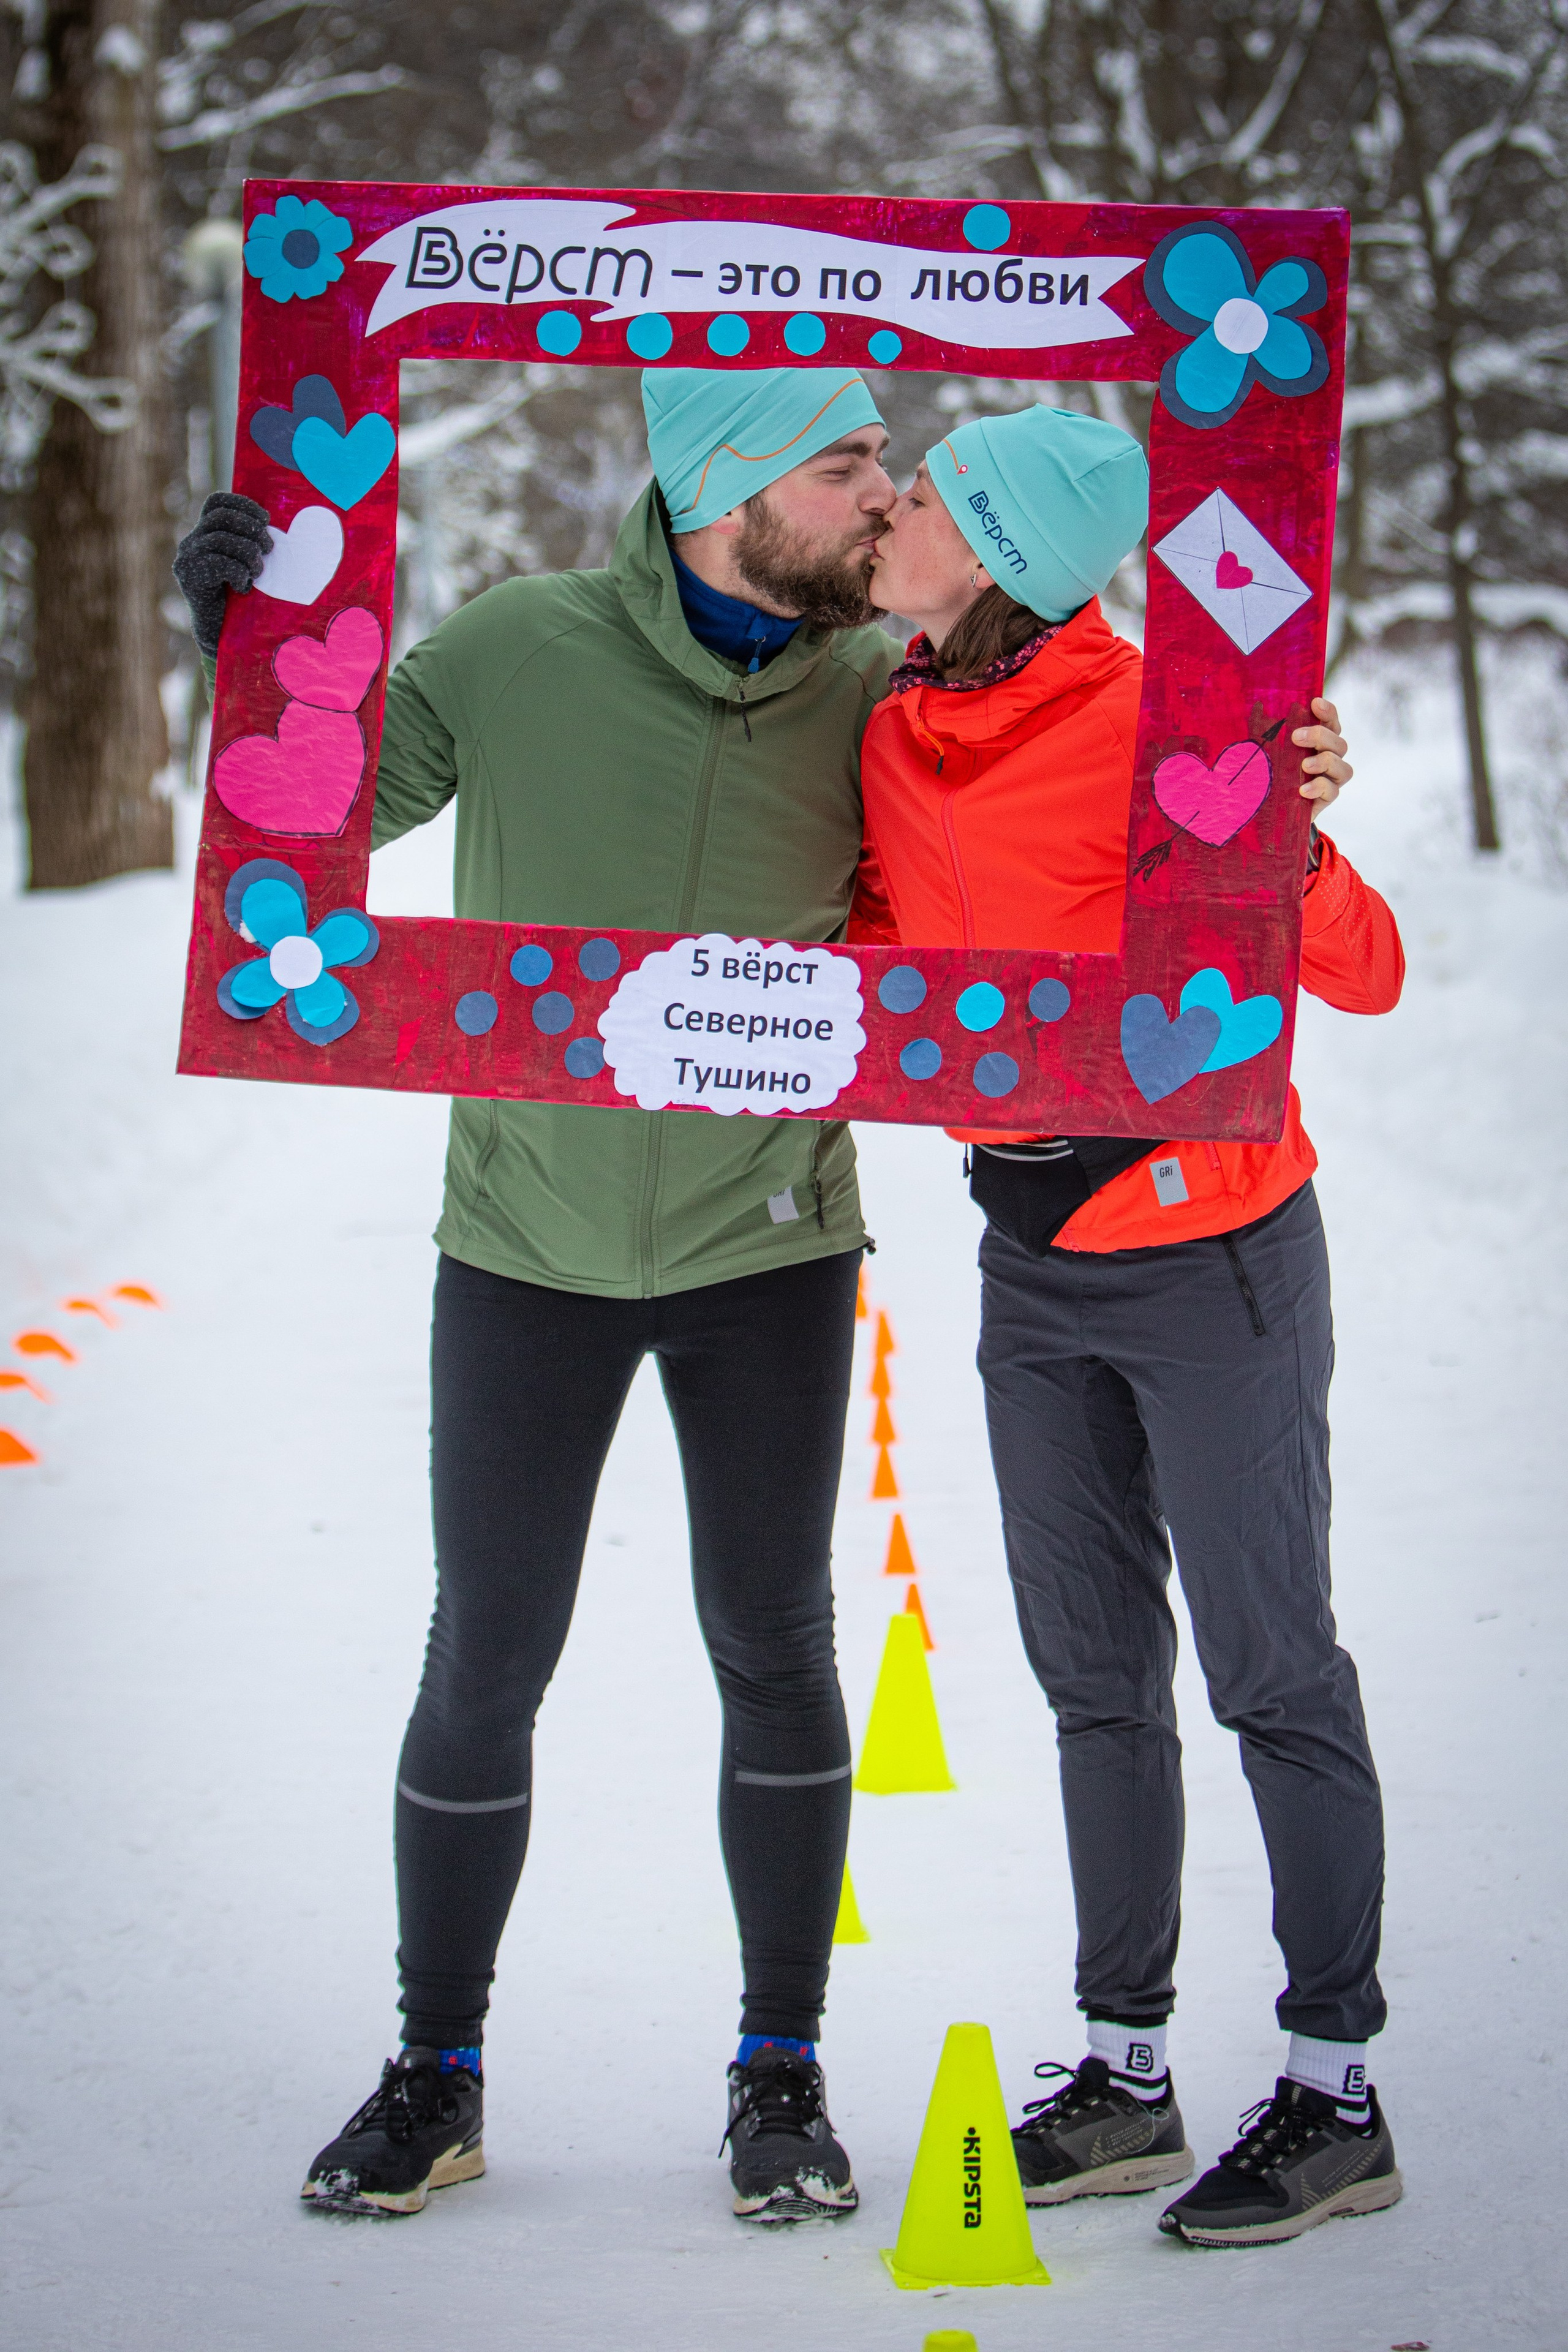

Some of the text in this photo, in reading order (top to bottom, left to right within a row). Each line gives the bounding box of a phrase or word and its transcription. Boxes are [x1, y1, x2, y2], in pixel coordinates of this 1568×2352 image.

[405, 226, 653, 304] Вёрст
[718, 262, 801, 298] это
[819, 268, 882, 301] по
[910, 258, 1090, 306] любви
[691, 949, 818, 989] 5 вёрст
[663, 1002, 834, 1043] Северное
[674, 1057, 811, 1094] Тушино
